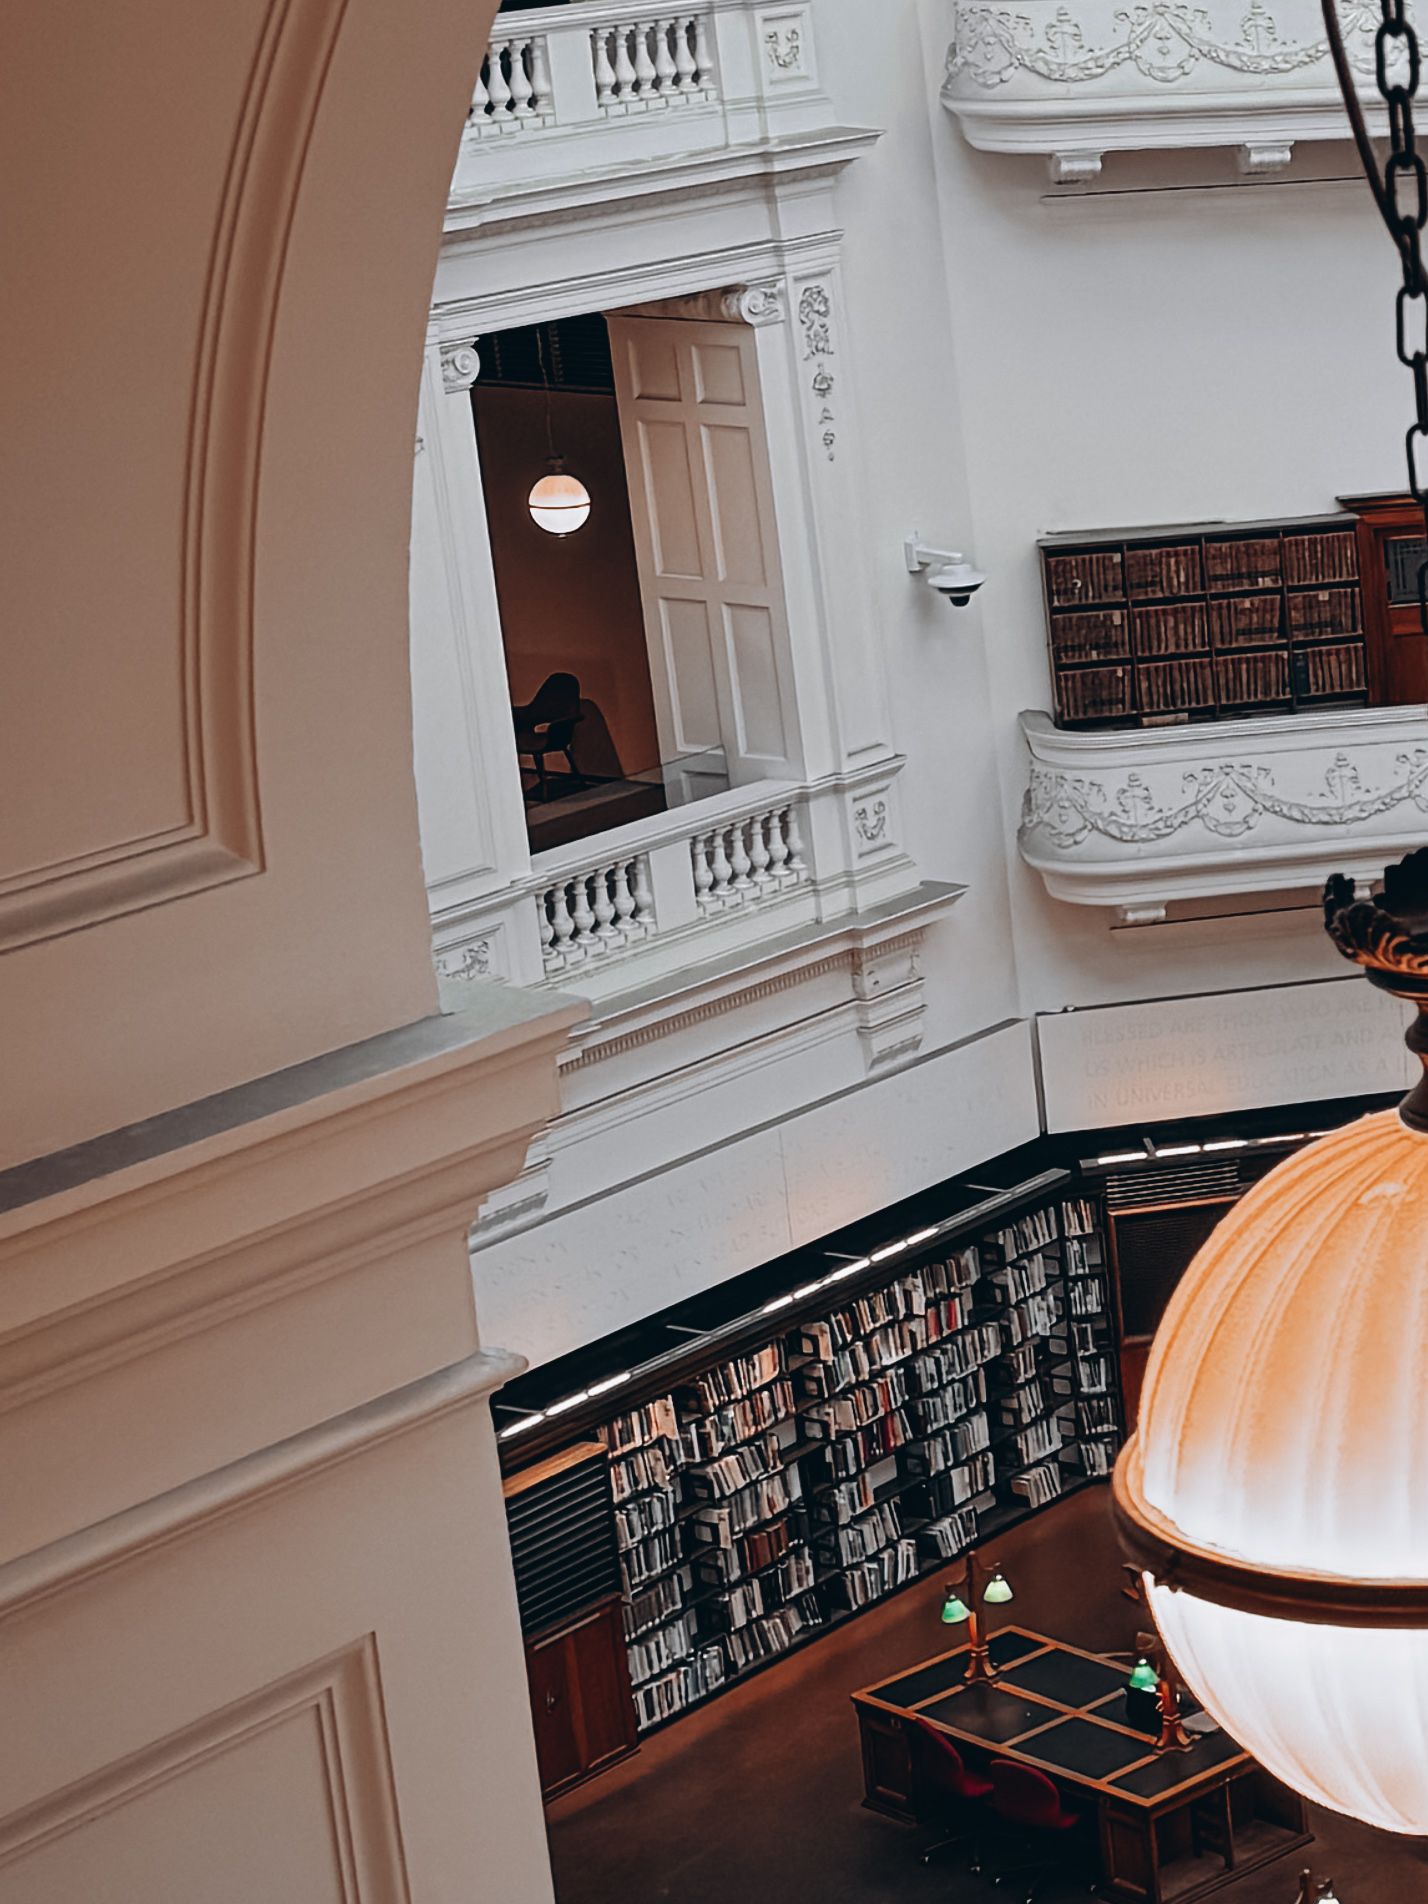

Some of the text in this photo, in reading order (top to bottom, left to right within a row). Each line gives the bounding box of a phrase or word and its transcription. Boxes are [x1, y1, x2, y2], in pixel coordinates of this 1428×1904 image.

[1080, 1021, 1162, 1046] BLESSED
[1168, 1015, 1207, 1036] ARE
[1118, 1049, 1184, 1073] WHICH
